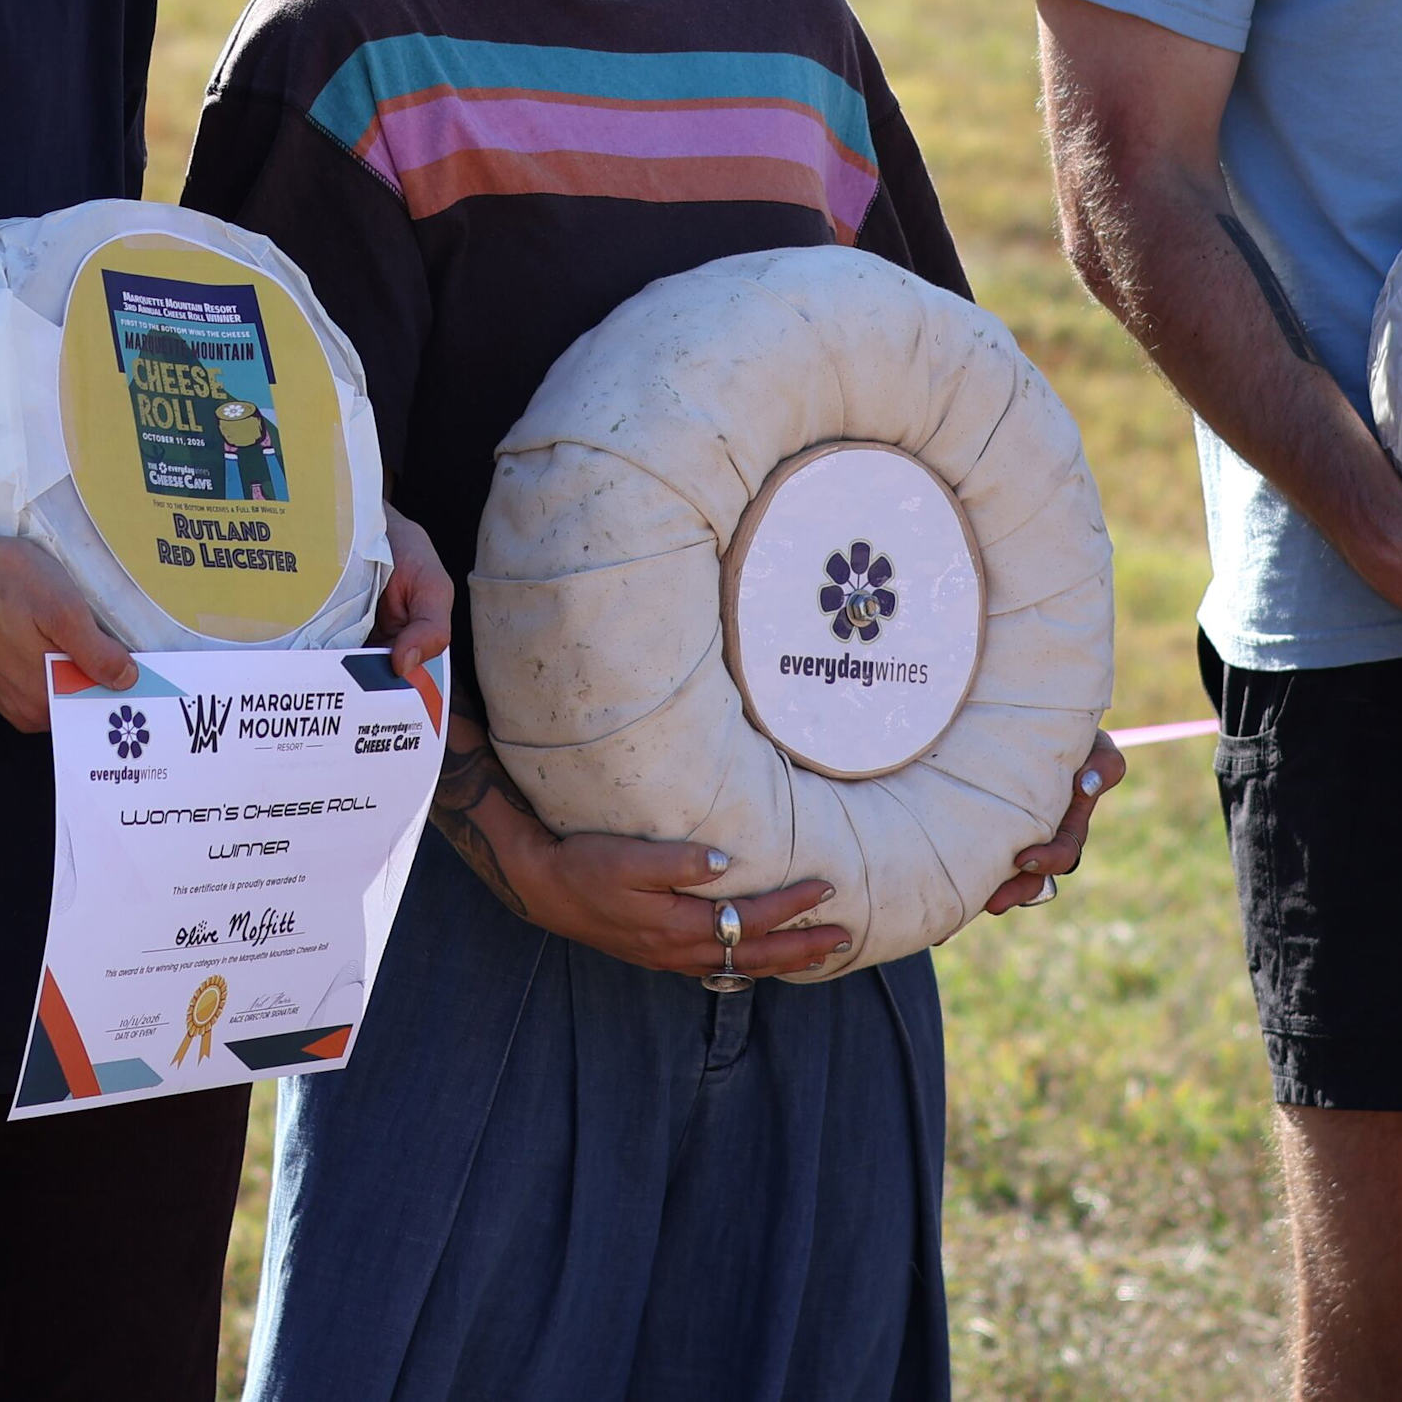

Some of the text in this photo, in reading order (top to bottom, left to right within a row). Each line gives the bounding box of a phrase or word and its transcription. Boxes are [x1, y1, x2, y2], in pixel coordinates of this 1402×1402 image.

[122, 291, 237, 314] MARQUETTE MOUNTAIN RESORT
[163, 307, 187, 320] CHEESE
[187, 311, 206, 322] ROLL
[205, 313, 242, 323] WINNER
[120, 318, 138, 327] FIRST
[139, 321, 148, 329] TO
[148, 323, 160, 331] THE
[160, 325, 188, 335] BOTTOM
[188, 328, 206, 337] WINS
[206, 330, 220, 338] THE
[190, 340, 255, 361] MOUNTAIN
[132, 357, 227, 399] CHEESE
[136, 393, 203, 432] ROLL
[142, 432, 175, 445] OCTOBER
[175, 437, 186, 446] 11,
[149, 470, 214, 491] CHEESE CAVE
[173, 513, 271, 542] RUTLAND
[156, 538, 298, 573] RED LEICESTER
[779, 652, 928, 687] everydaywines
[241, 692, 345, 712] MARQUETTE
[239, 716, 341, 739] MOUNTAIN
[358, 725, 371, 735] THE
[276, 742, 304, 752] RESORT
[354, 734, 421, 754] CHEESE CAVE
[90, 765, 168, 784] everydaywines
[121, 796, 377, 826] WOMEN'S CHEESE ROLL
[208, 840, 290, 860] WINNER
[173, 874, 306, 895] This certificate is proudly awarded to
[175, 907, 295, 948] Olive Moffitt
[105, 969, 117, 978] This
[118, 967, 139, 977] award
[139, 967, 145, 975] is
[146, 965, 155, 974] for
[156, 963, 179, 973] winning
[179, 961, 193, 972] your
[194, 958, 221, 969] category
[221, 956, 227, 964] in
[228, 955, 238, 963] the
[239, 951, 269, 964] Marquette
[269, 947, 296, 958] Mountain
[296, 944, 318, 954] Cheese
[114, 1030, 130, 1041] DATE
[130, 1029, 139, 1039] OF
